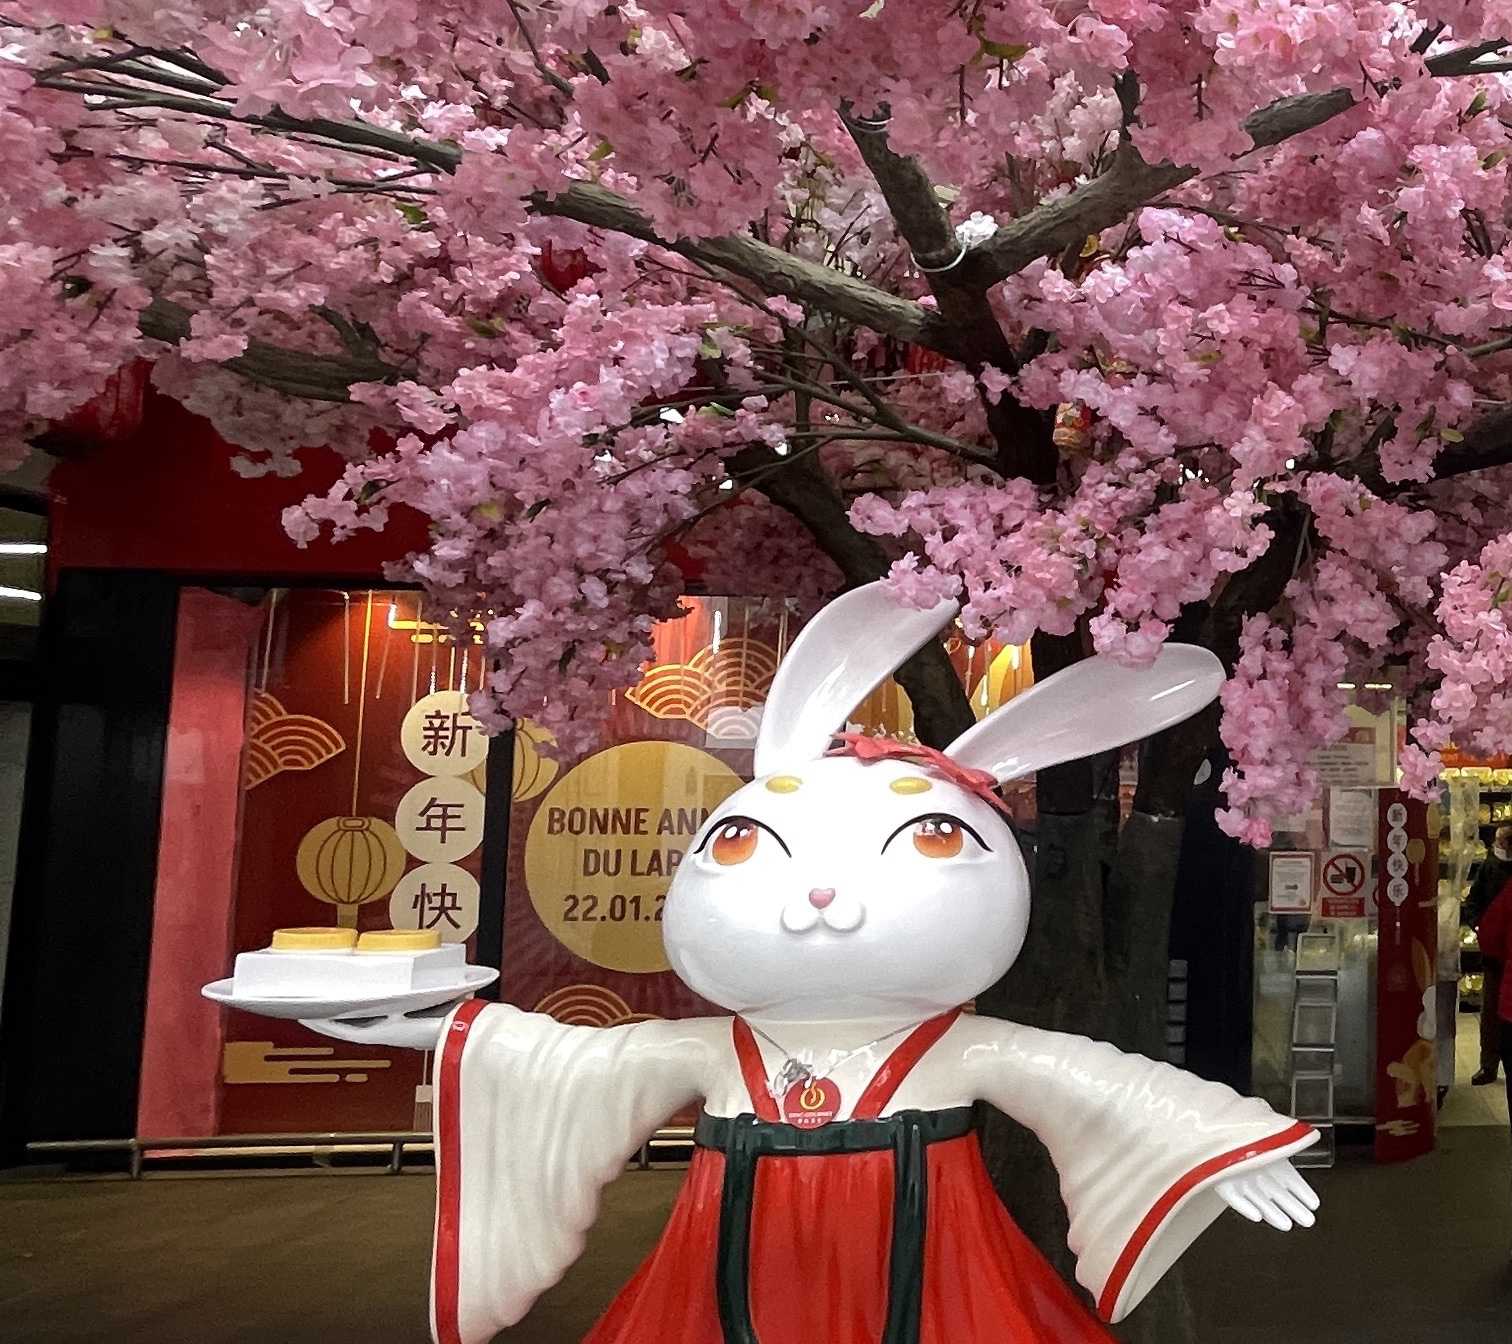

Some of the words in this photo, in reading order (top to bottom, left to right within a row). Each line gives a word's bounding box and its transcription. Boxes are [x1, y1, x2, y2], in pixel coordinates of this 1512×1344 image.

[547, 807, 650, 836] BONNE
[582, 848, 622, 877] DU
[629, 848, 684, 877] LAP
[562, 894, 667, 922] 22.01.2
